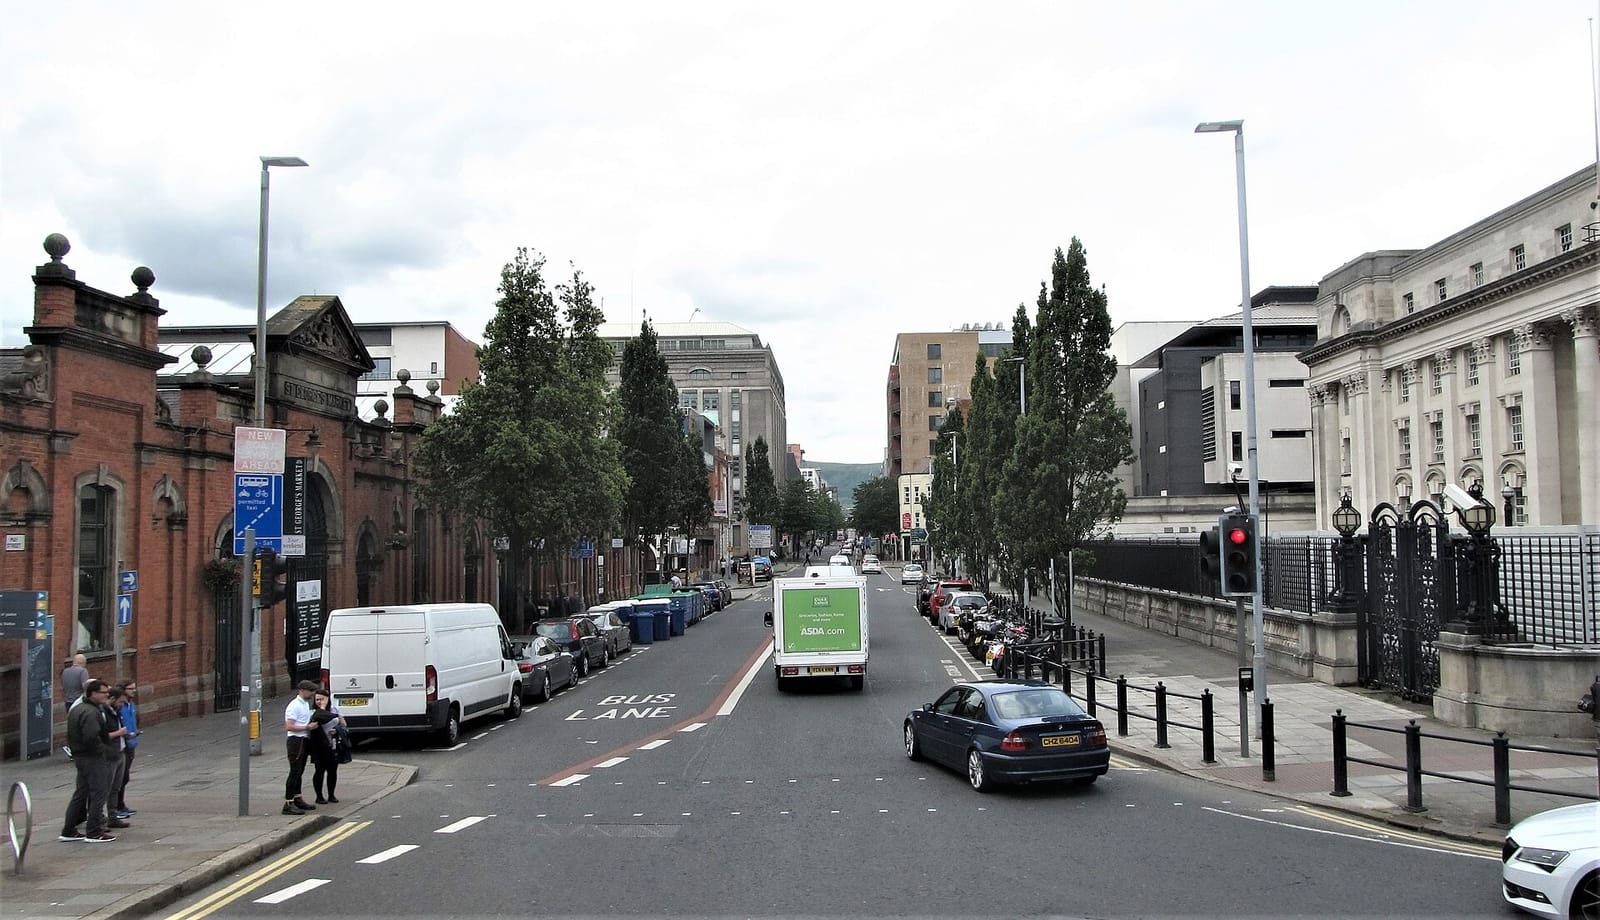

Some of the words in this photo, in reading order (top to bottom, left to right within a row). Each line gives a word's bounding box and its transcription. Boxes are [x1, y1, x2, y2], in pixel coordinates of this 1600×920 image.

[248, 431, 273, 440] NEW
[240, 461, 279, 470] AHEAD
[295, 464, 304, 491] MARKET
[294, 492, 303, 525] GEORGE'S
[294, 526, 303, 534] ST
[597, 693, 676, 706] BUS
[564, 706, 678, 721] LANE
[1043, 737, 1058, 745] CHZ
